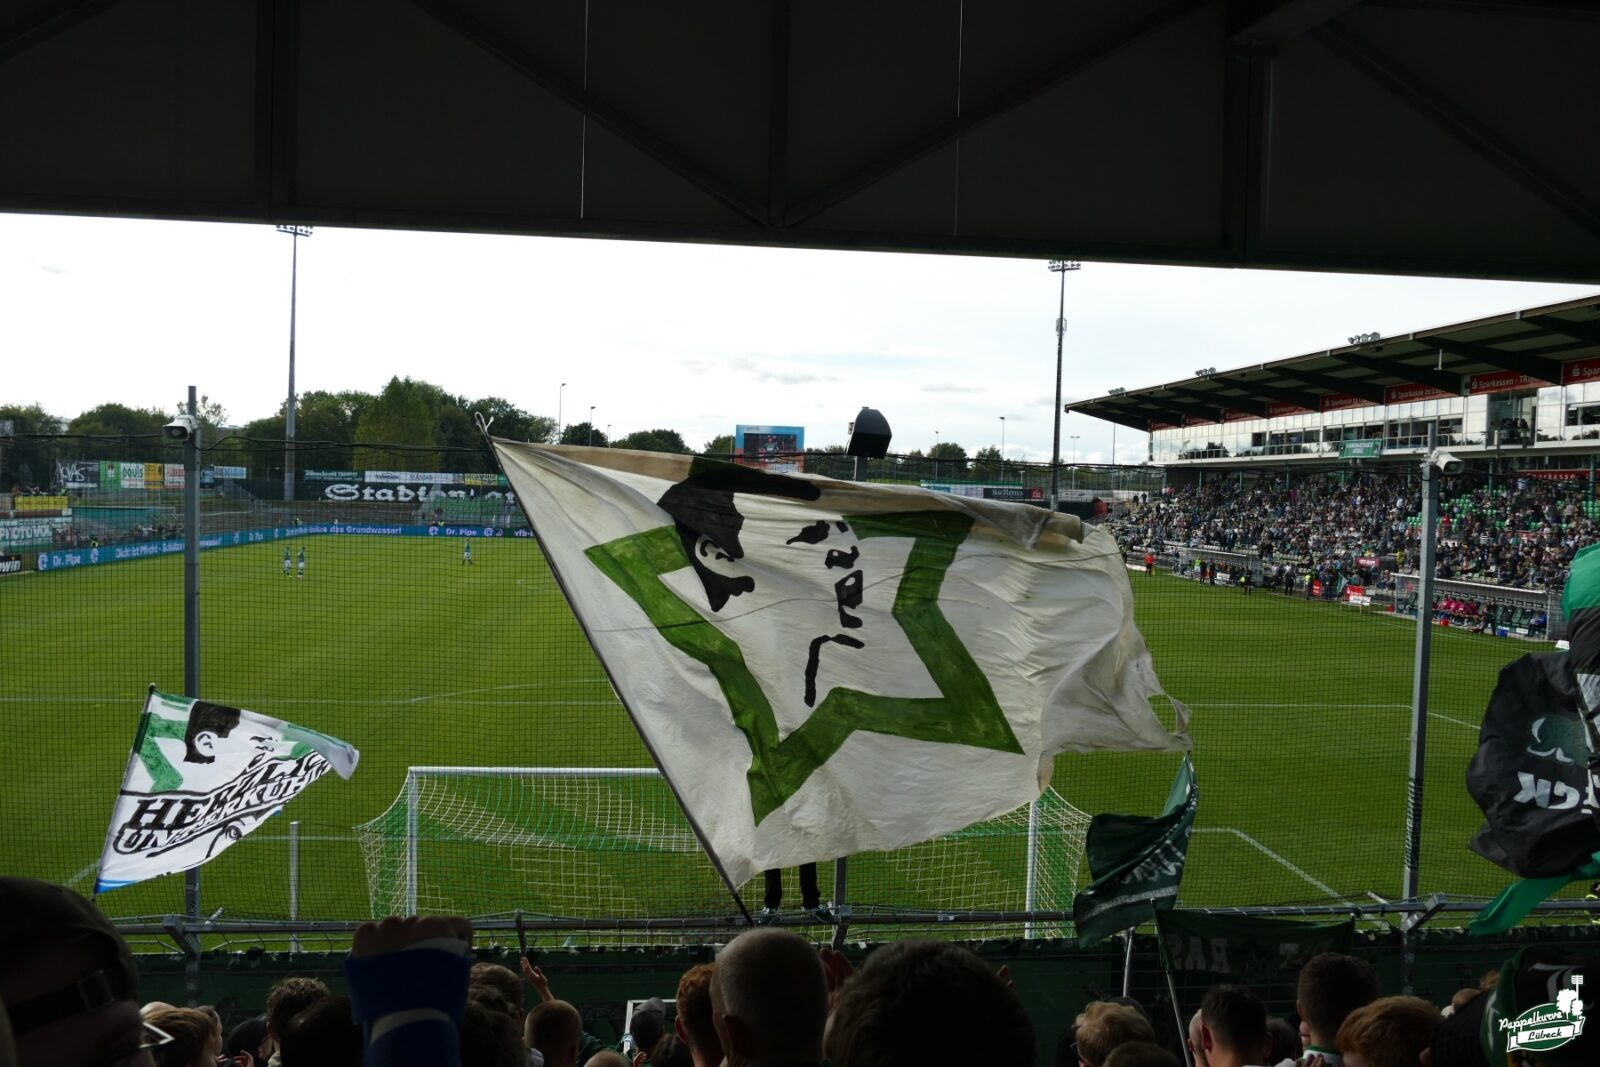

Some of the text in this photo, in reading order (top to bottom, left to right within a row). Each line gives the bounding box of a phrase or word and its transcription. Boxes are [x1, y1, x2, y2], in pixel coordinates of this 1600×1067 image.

[459, 528, 477, 537] Pipe
[53, 553, 81, 566] Dr. Pipe
